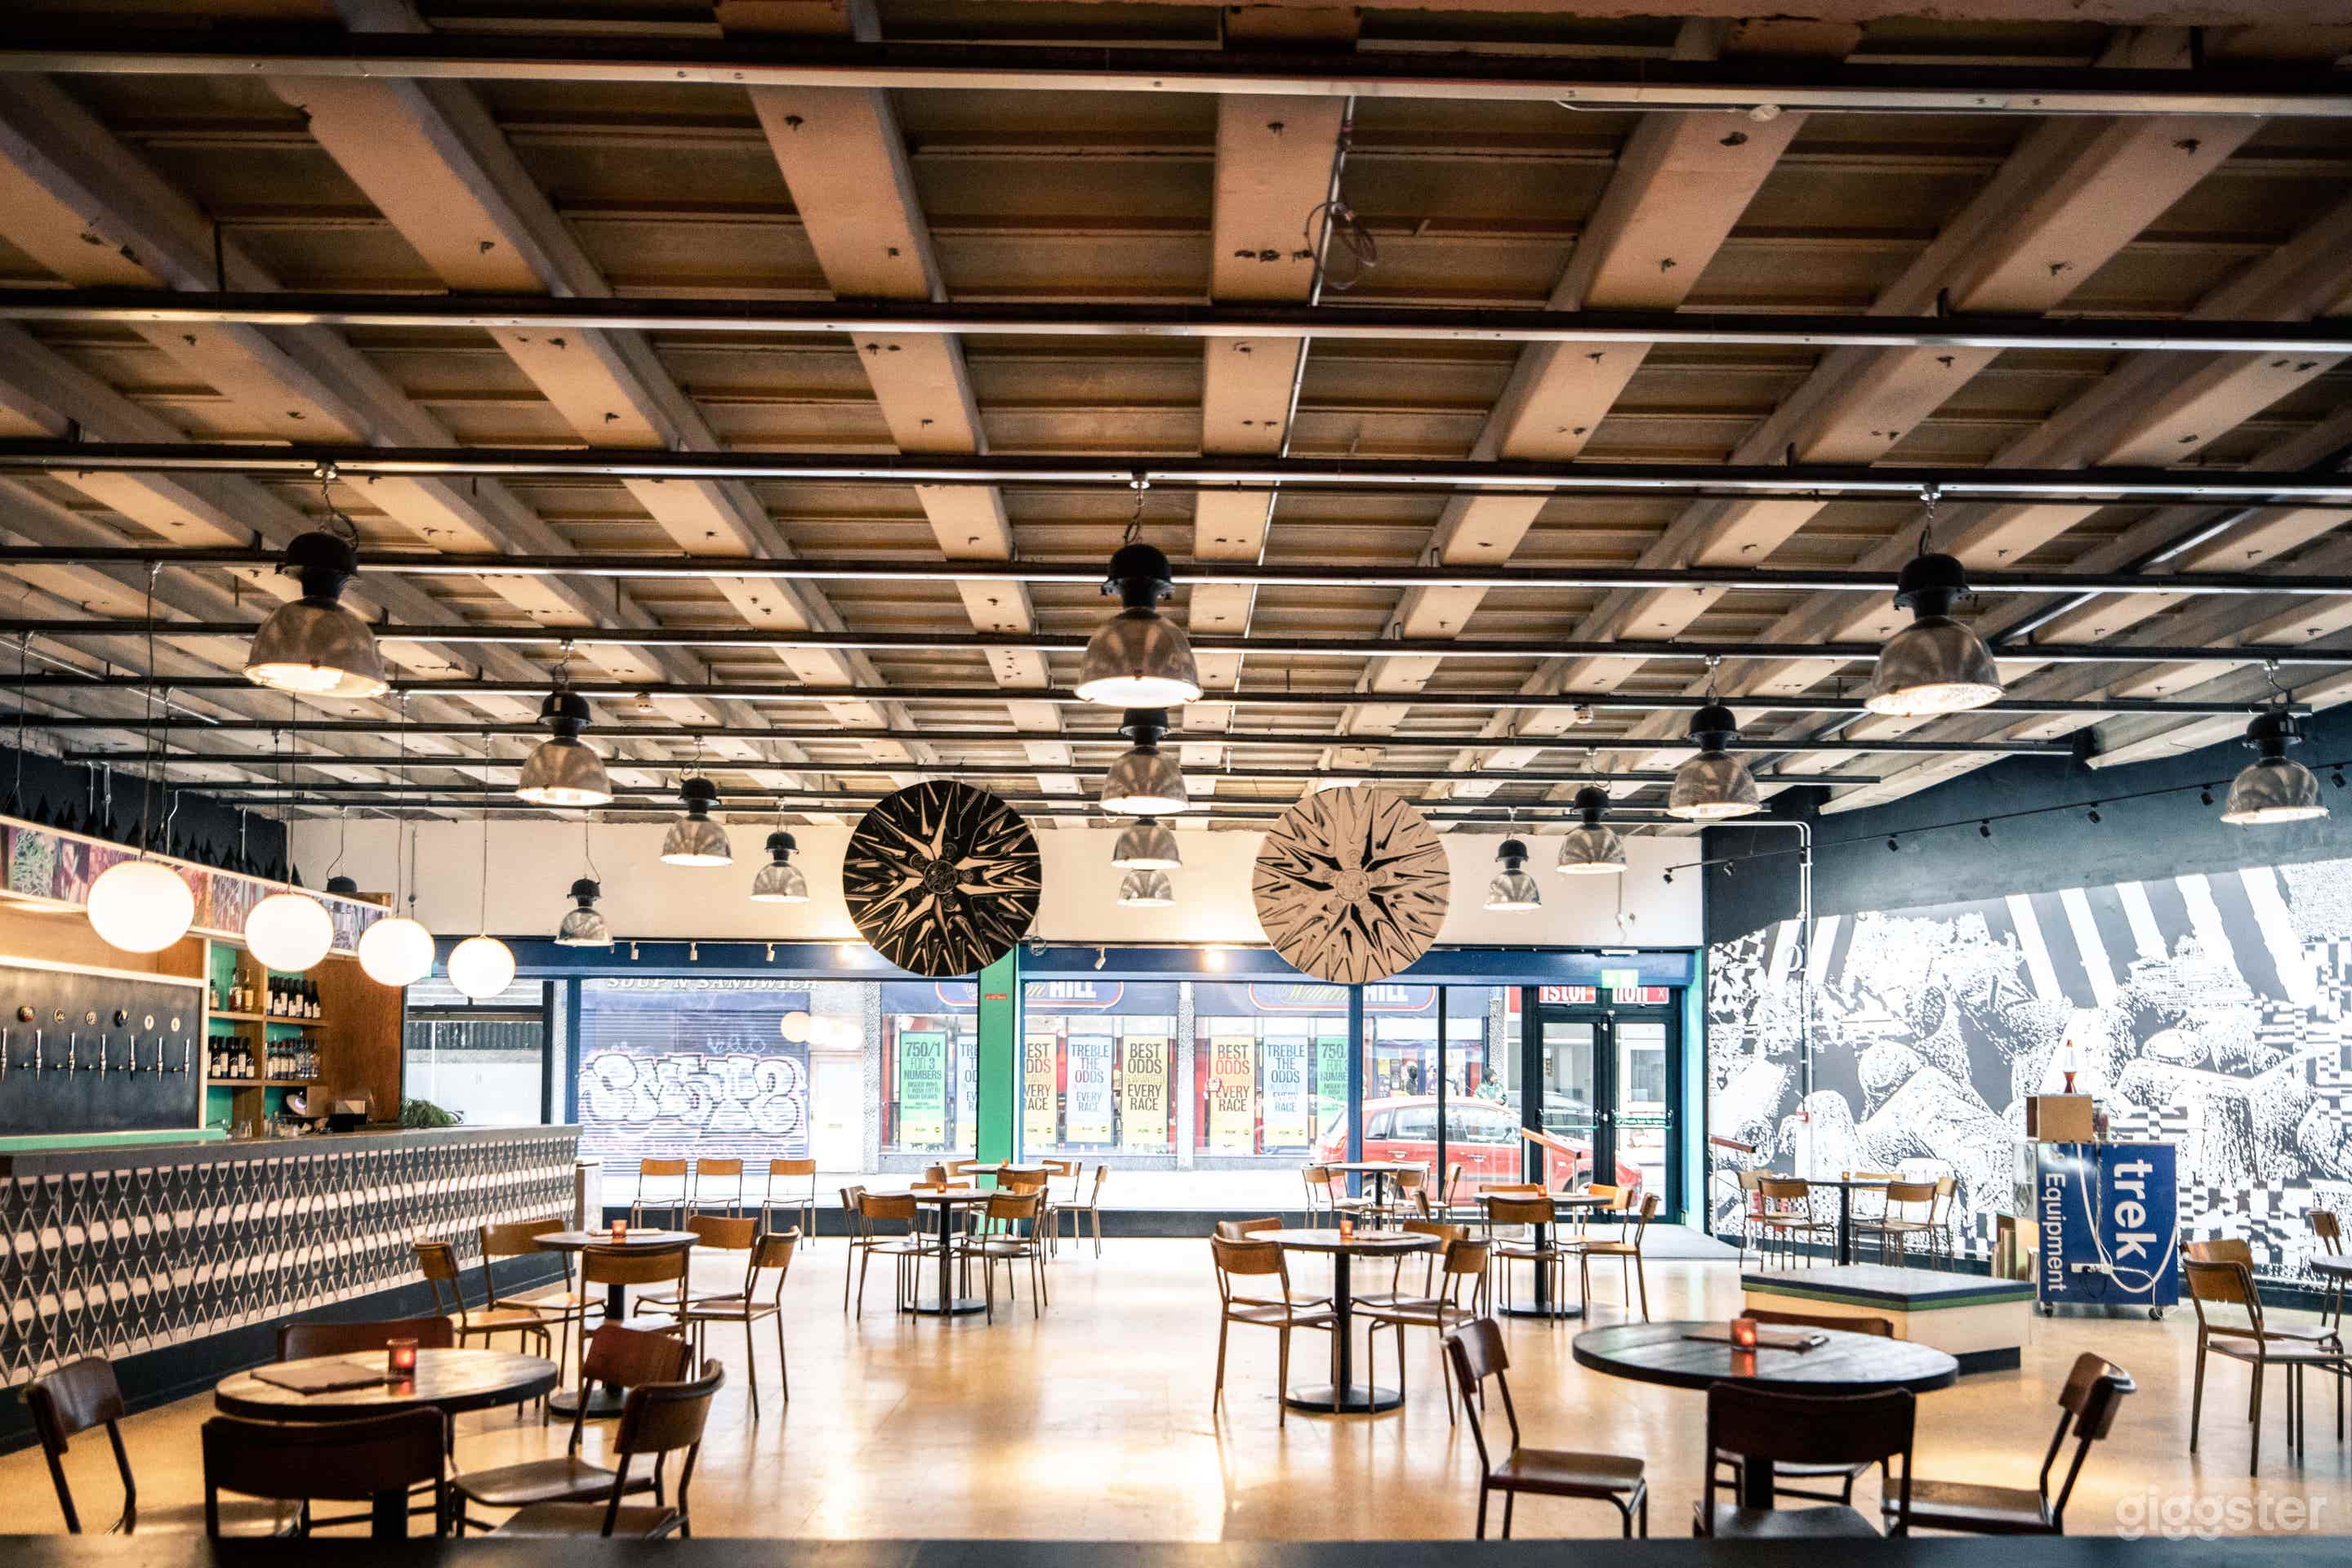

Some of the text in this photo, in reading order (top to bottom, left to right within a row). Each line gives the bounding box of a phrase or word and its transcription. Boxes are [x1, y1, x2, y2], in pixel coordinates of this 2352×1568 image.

[905, 1041, 941, 1057] 750/1
[1026, 1043, 1051, 1058] EST
[1071, 1044, 1109, 1058] TREBLE
[1129, 1043, 1161, 1058] BEST
[1218, 1045, 1248, 1059] BEST
[1267, 1045, 1305, 1058] TREBLE
[929, 1057, 935, 1070] 3
[1026, 1058, 1051, 1073] DDS
[1080, 1058, 1098, 1069] THE
[1128, 1058, 1162, 1074] ODDS
[1215, 1059, 1250, 1075] ODDS
[1276, 1058, 1295, 1070] THE
[903, 1070, 942, 1080] NUMBERS
[1075, 1070, 1104, 1083] ODDS
[1271, 1070, 1300, 1084] ODDS
[1024, 1084, 1052, 1097] VERY
[1128, 1084, 1162, 1098] EVERY
[1130, 1097, 1159, 1111] RACE
[1218, 1098, 1247, 1111] RACE
[2114, 1159, 2158, 1261] trek
[2041, 1173, 2068, 1293] Equipment
